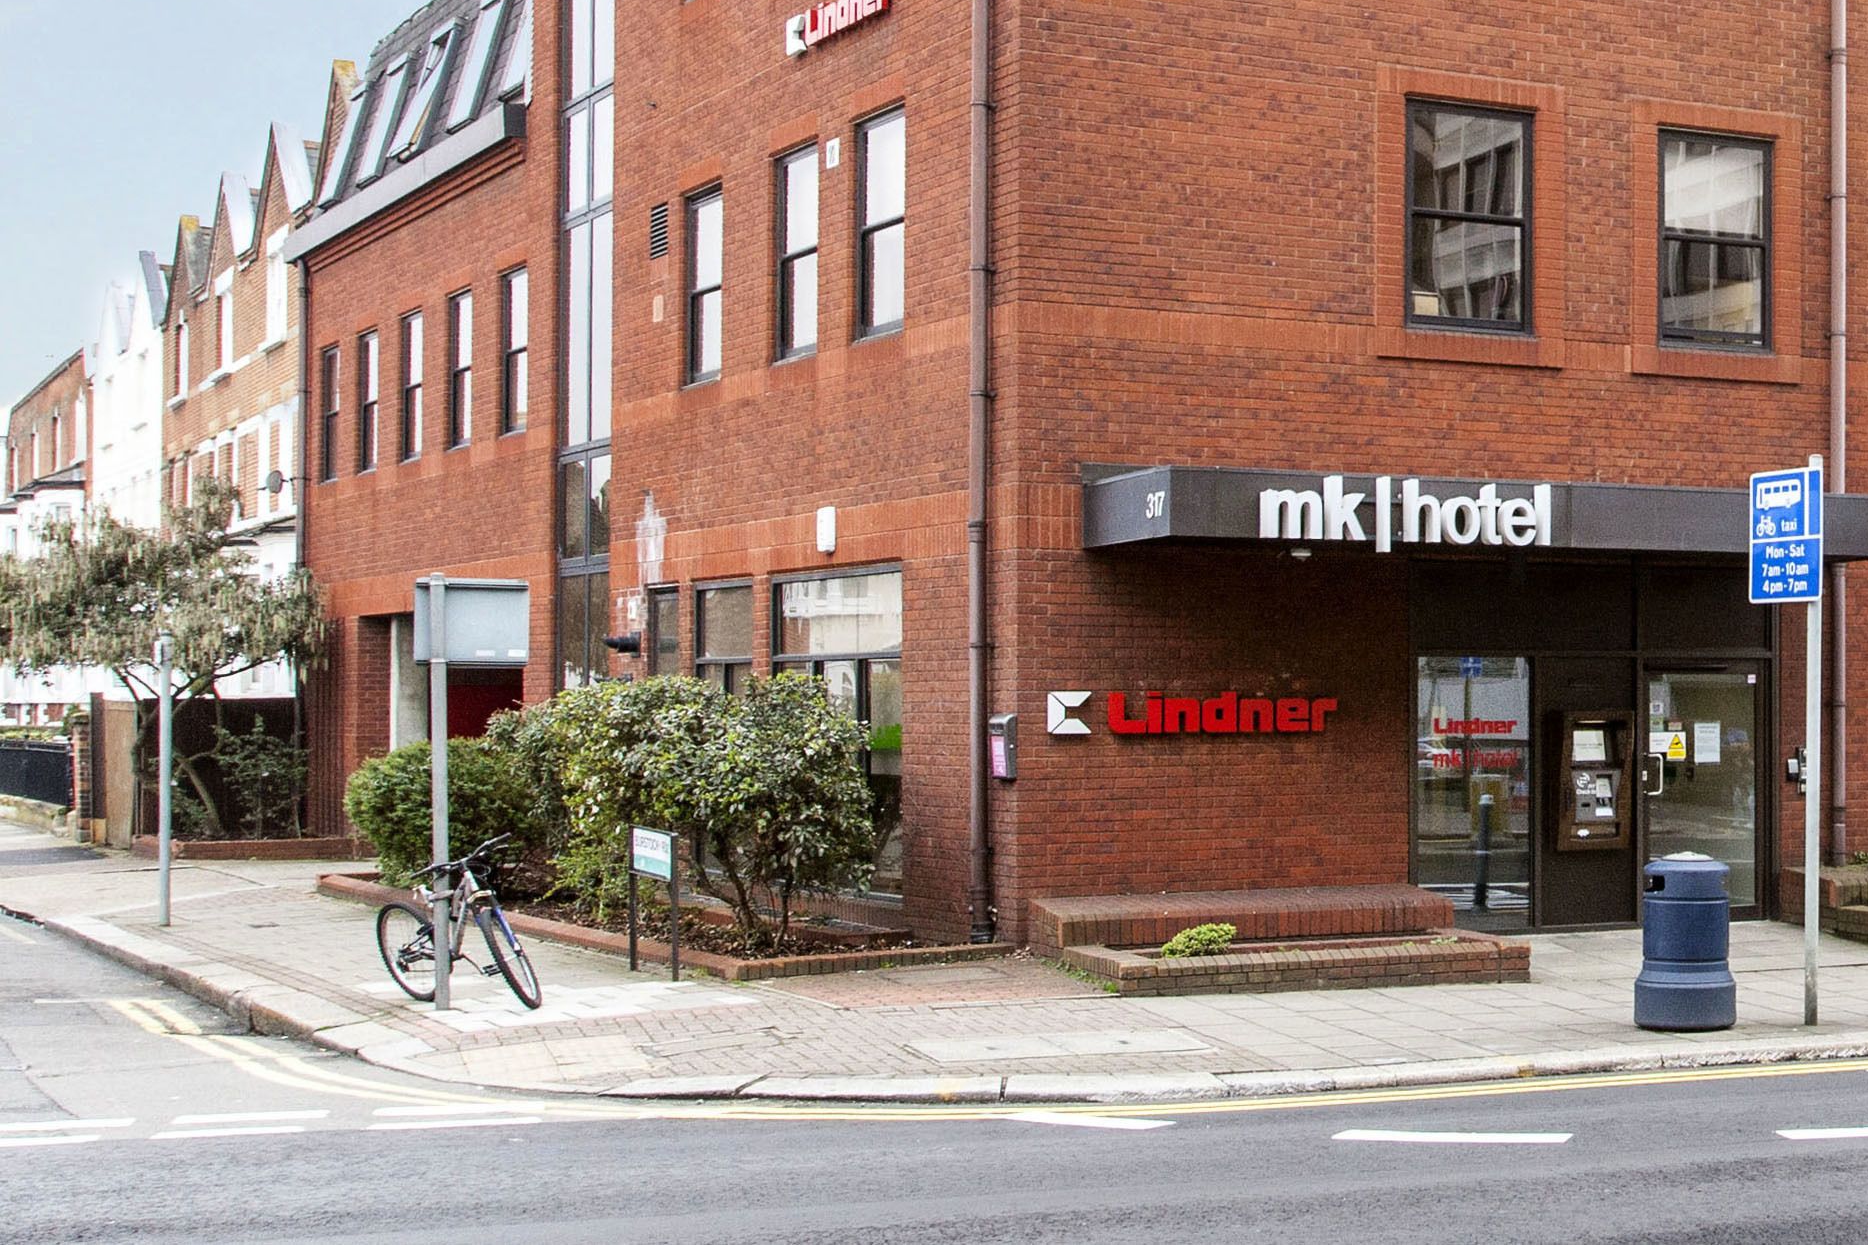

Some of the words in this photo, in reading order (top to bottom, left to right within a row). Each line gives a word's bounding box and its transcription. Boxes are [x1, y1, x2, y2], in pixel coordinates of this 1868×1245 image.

[1145, 490, 1166, 520] 317
[1781, 517, 1798, 532] taxi
[1107, 690, 1338, 735] Lindner
[1433, 717, 1518, 734] Lindner
